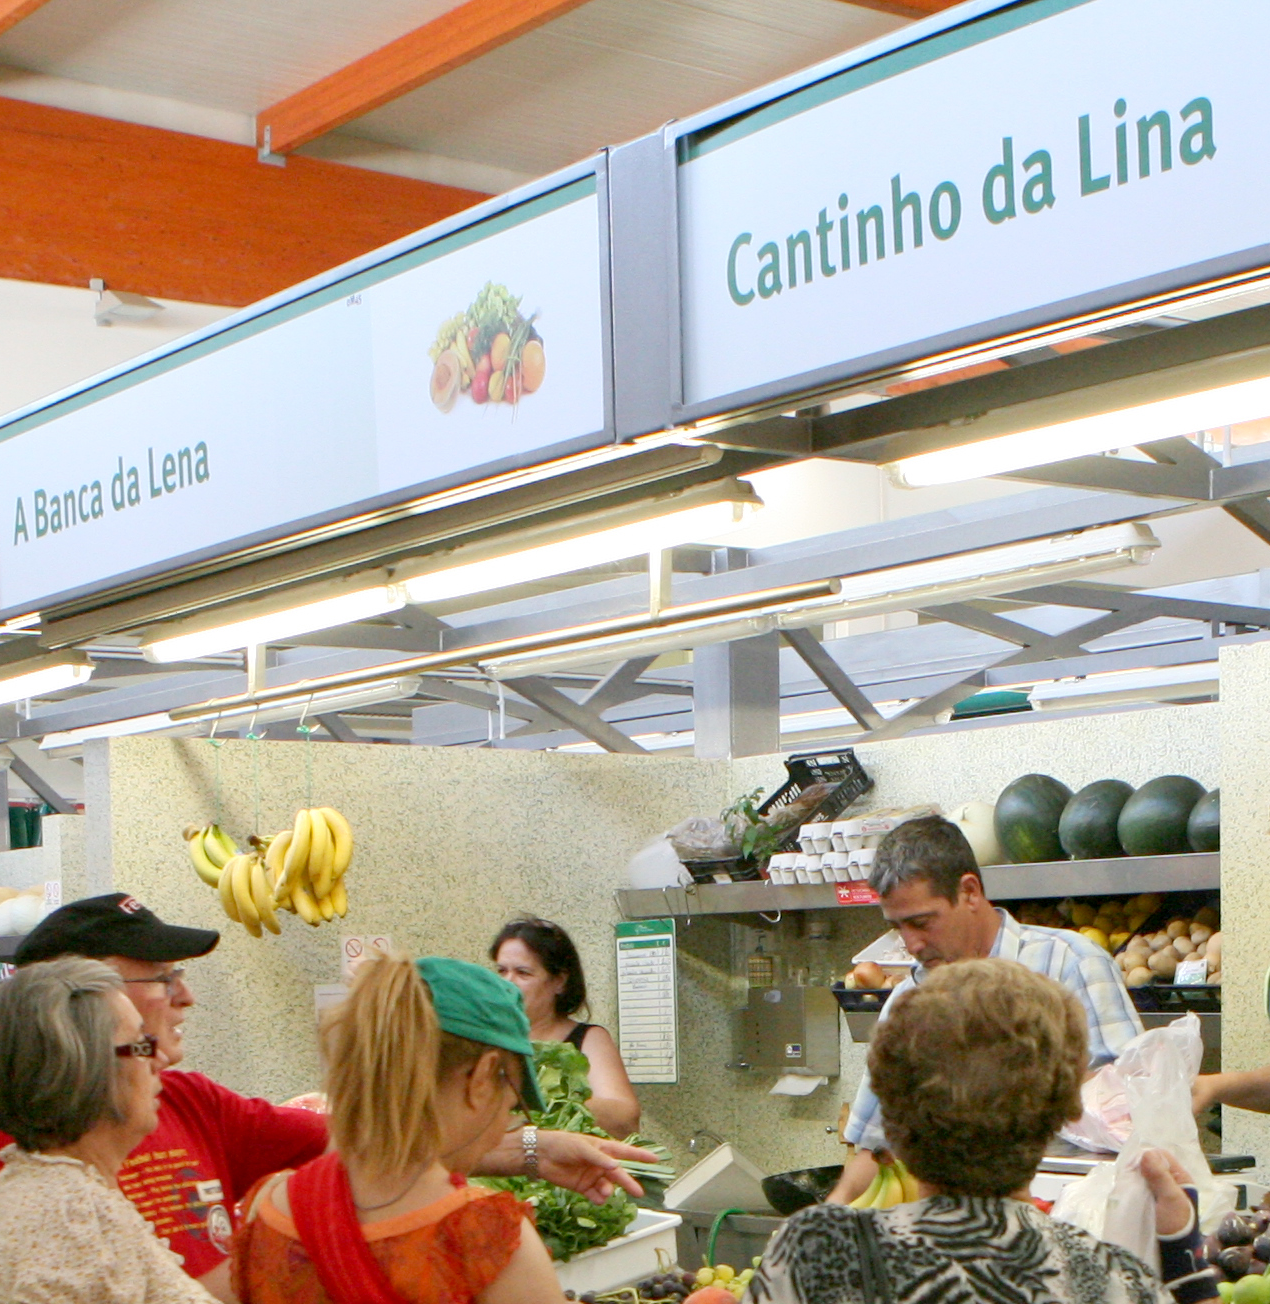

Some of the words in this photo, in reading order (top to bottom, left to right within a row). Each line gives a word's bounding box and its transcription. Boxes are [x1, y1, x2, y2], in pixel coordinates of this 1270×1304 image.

[727, 173, 961, 306] Cantinho
[982, 136, 1056, 225] da
[1078, 97, 1217, 197] Lina
[14, 496, 29, 546] A
[34, 479, 103, 539] Banca
[111, 456, 141, 511] da
[147, 441, 210, 499] Lena
